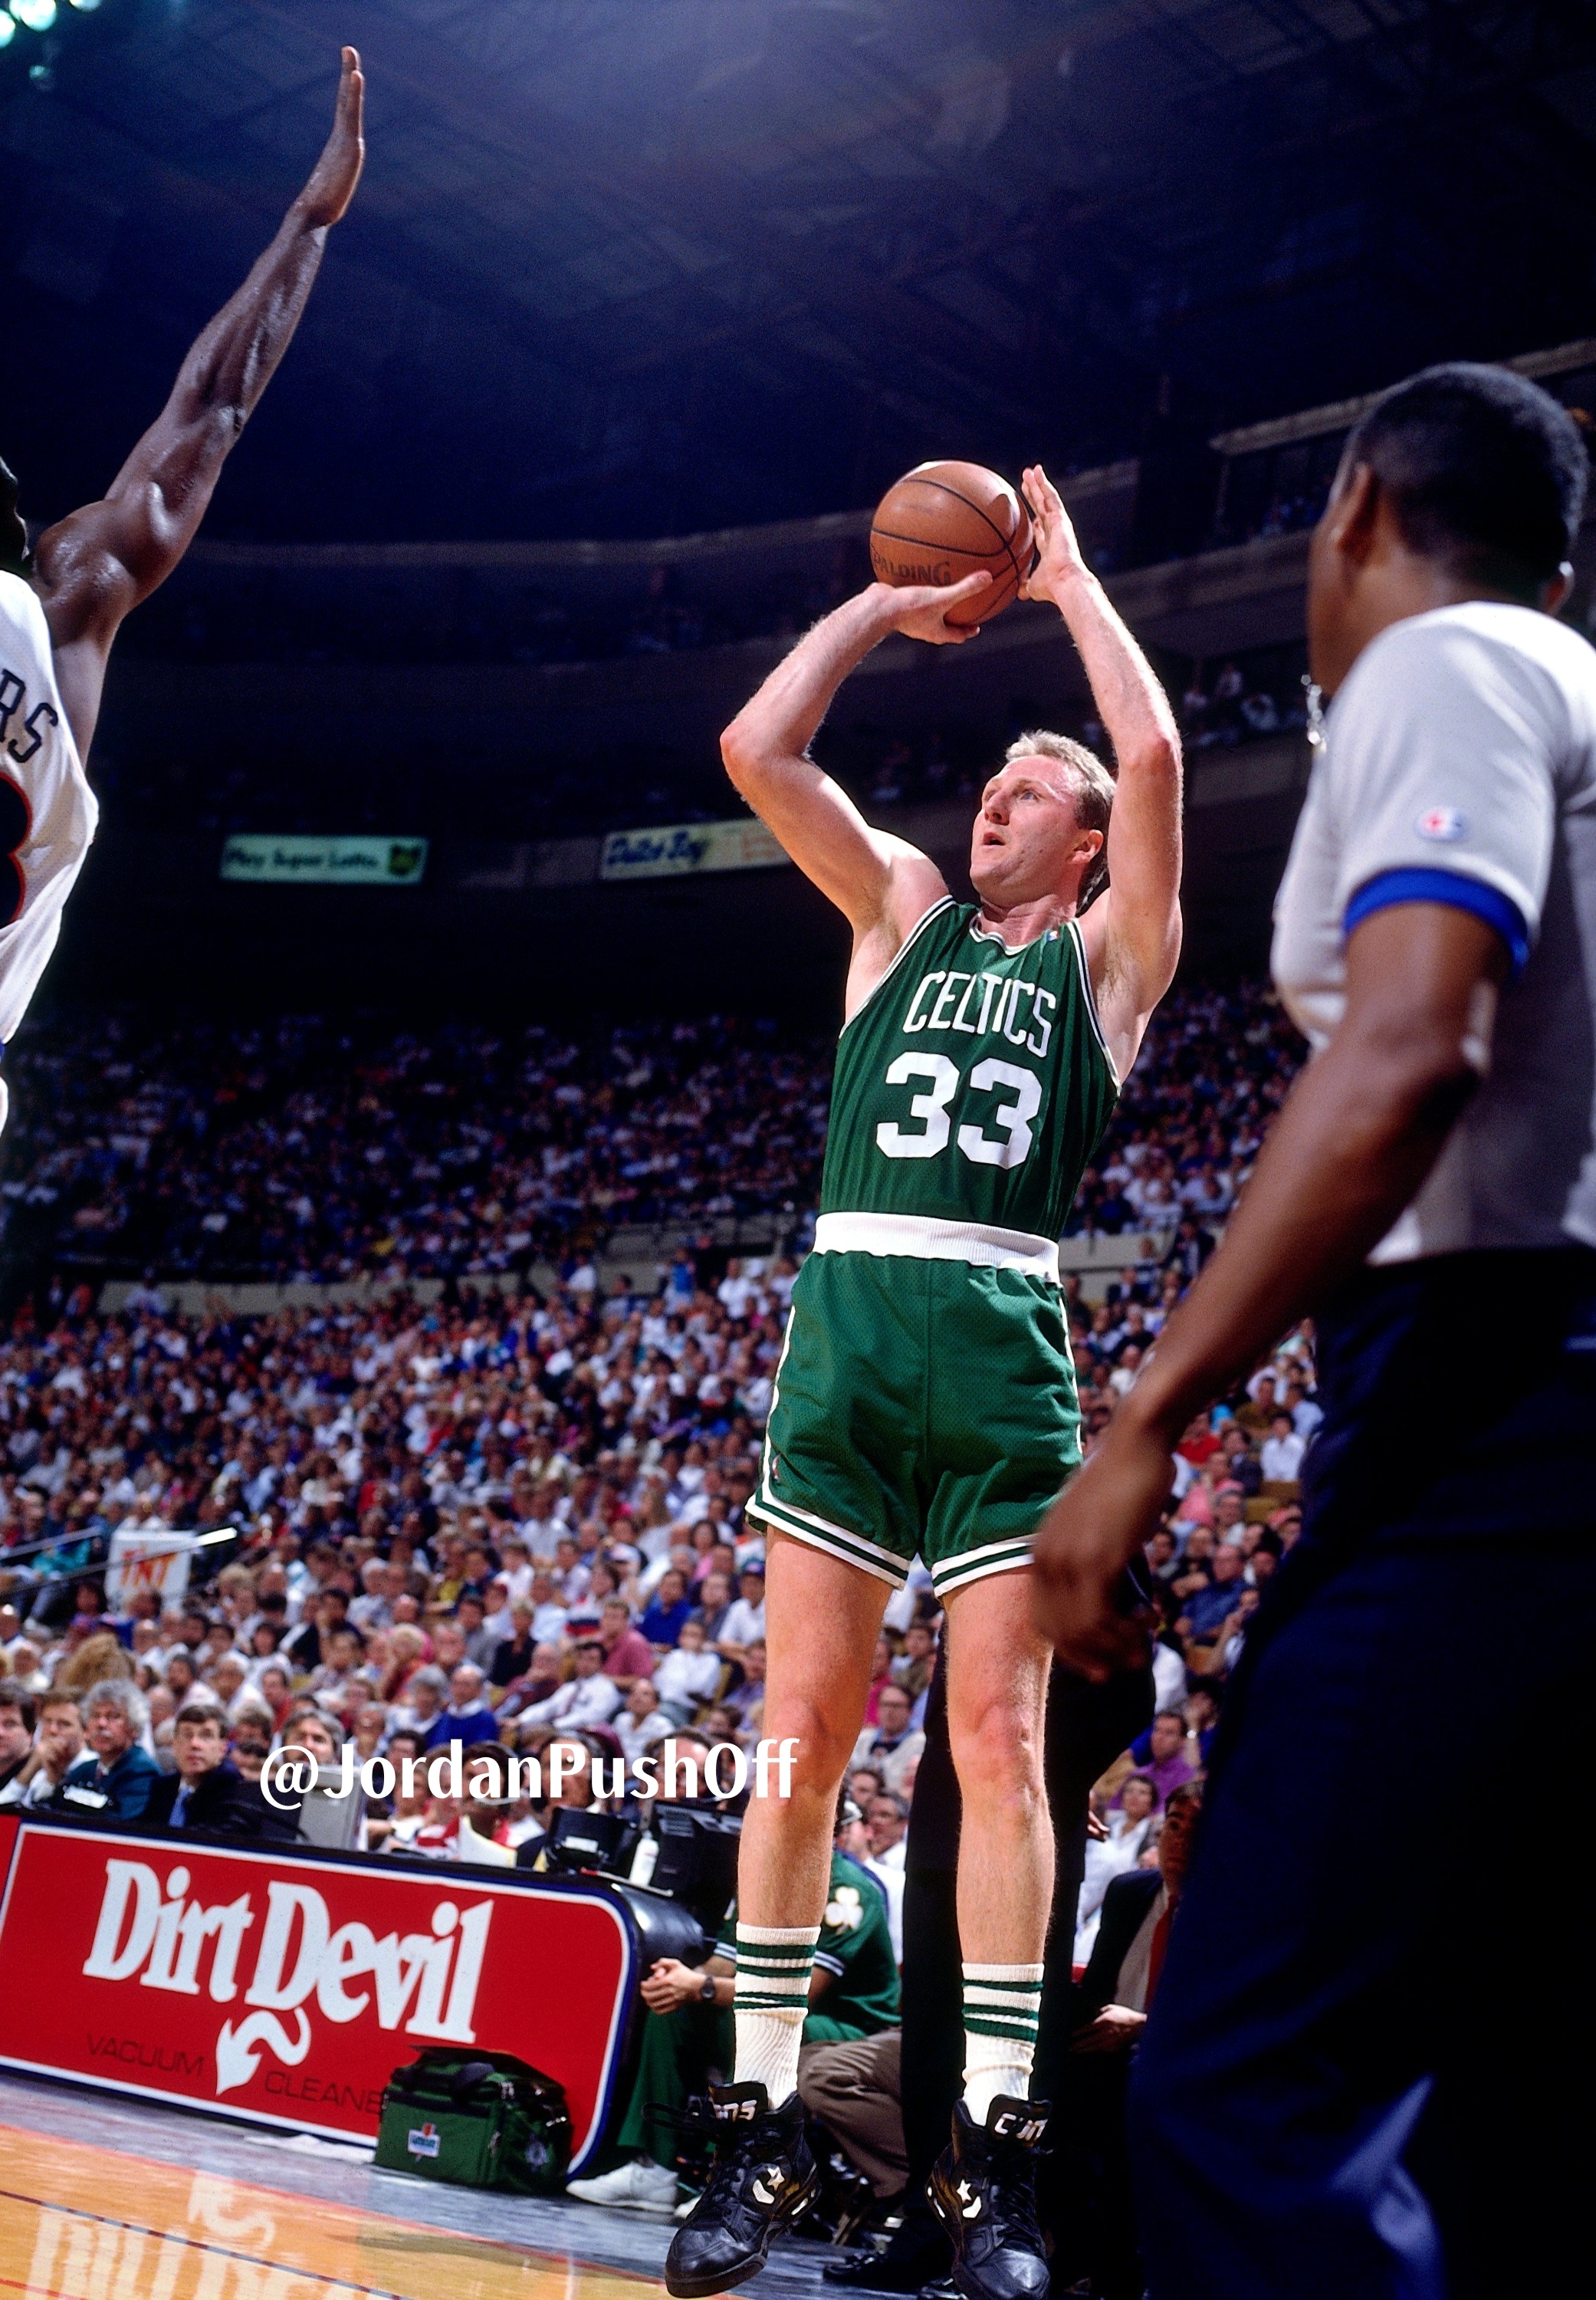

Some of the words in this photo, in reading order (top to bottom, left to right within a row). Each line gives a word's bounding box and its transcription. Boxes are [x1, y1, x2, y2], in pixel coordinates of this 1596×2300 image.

[903, 971, 1056, 1058] CELTICS
[876, 1051, 1043, 1170] 33
[82, 1858, 255, 2003] Dirt
[244, 1881, 494, 2044] Devil
[87, 2033, 205, 2078] VACUUM
[264, 2071, 383, 2116] CLEANE
